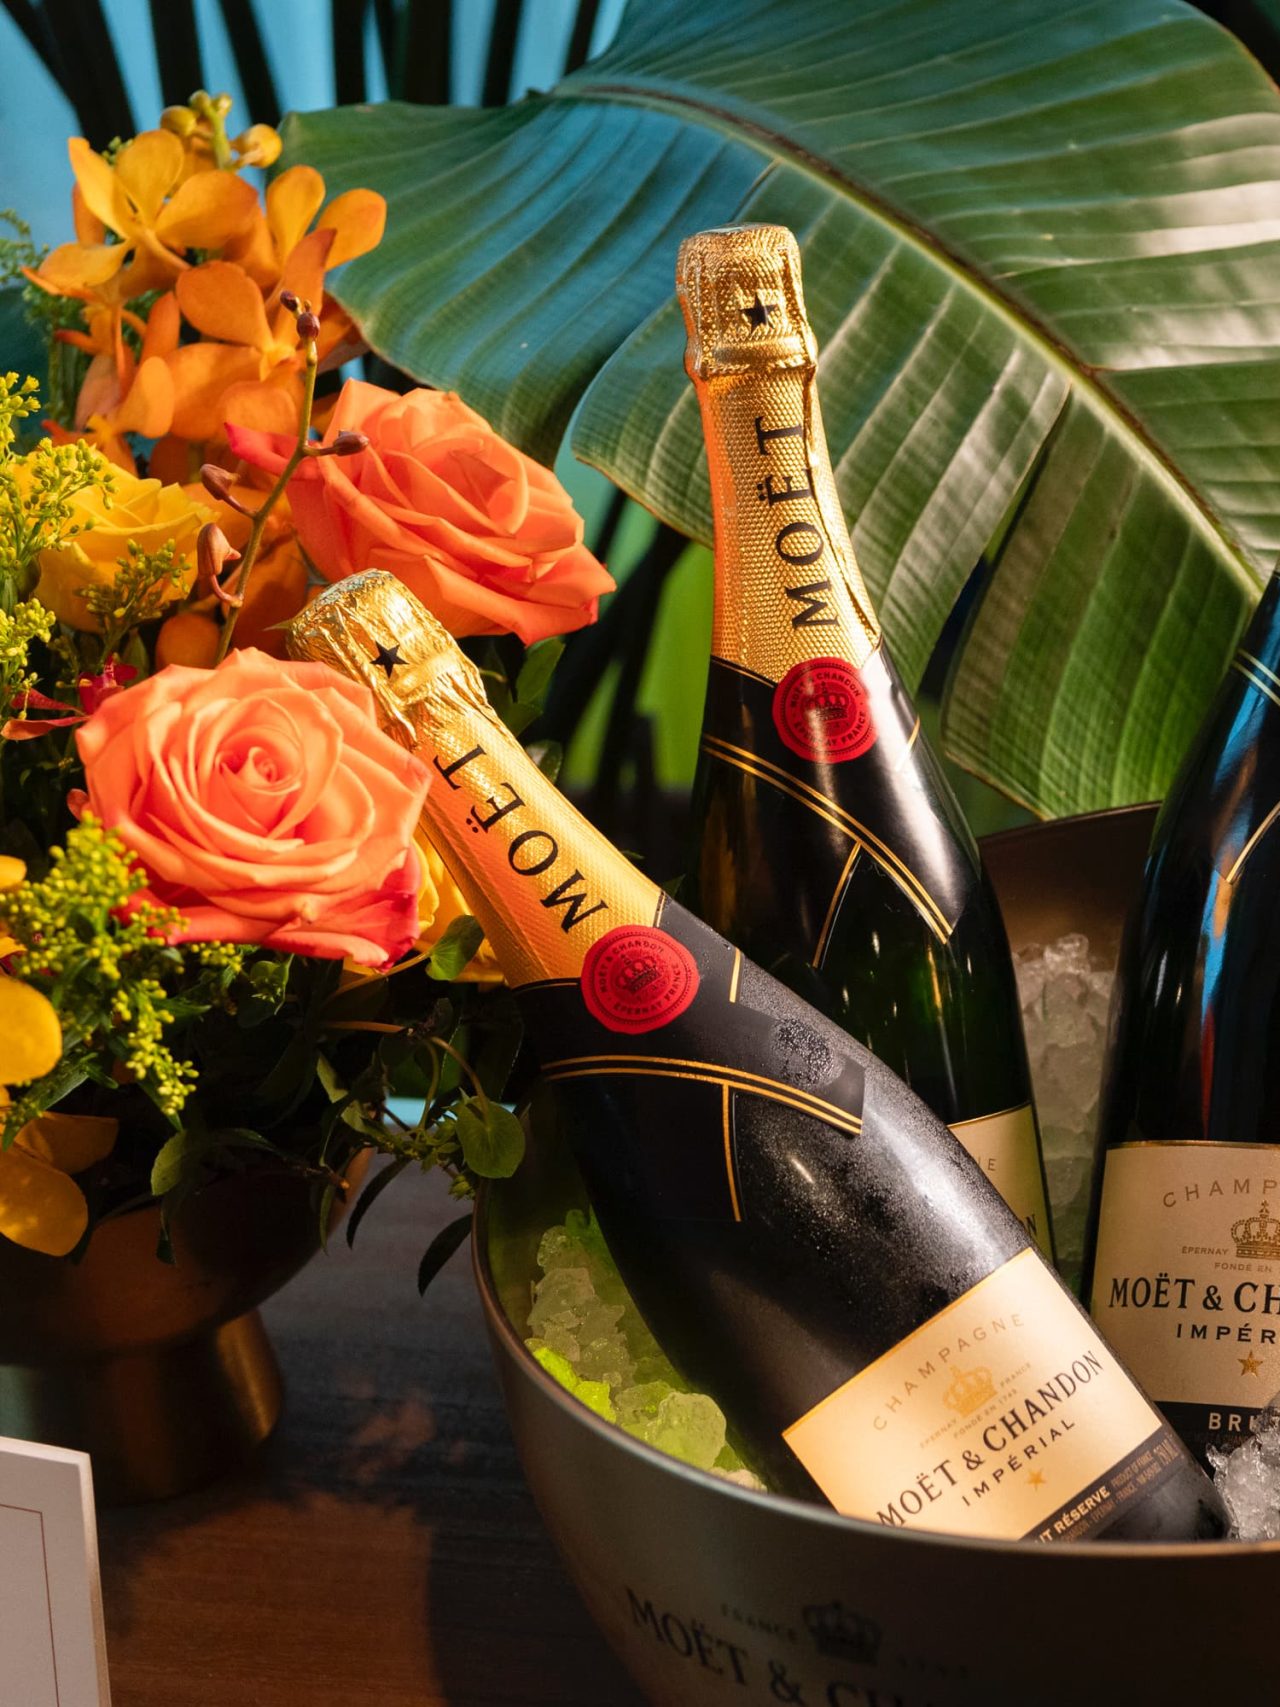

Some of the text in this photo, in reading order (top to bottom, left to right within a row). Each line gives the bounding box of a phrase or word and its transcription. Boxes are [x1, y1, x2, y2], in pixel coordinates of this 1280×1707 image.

[754, 415, 841, 631] MOËT
[432, 743, 610, 934] MOËT
[1108, 1272, 1196, 1310] MOËT
[1202, 1283, 1225, 1312] &
[1256, 1264, 1273, 1273] EN
[872, 1312, 1026, 1432] CHAMPAGNE
[877, 1350, 1105, 1528] MOËT & CHANDON
[961, 1419, 1077, 1508] IMPÉRIAL
[1053, 1485, 1111, 1534] RÉSERVE
